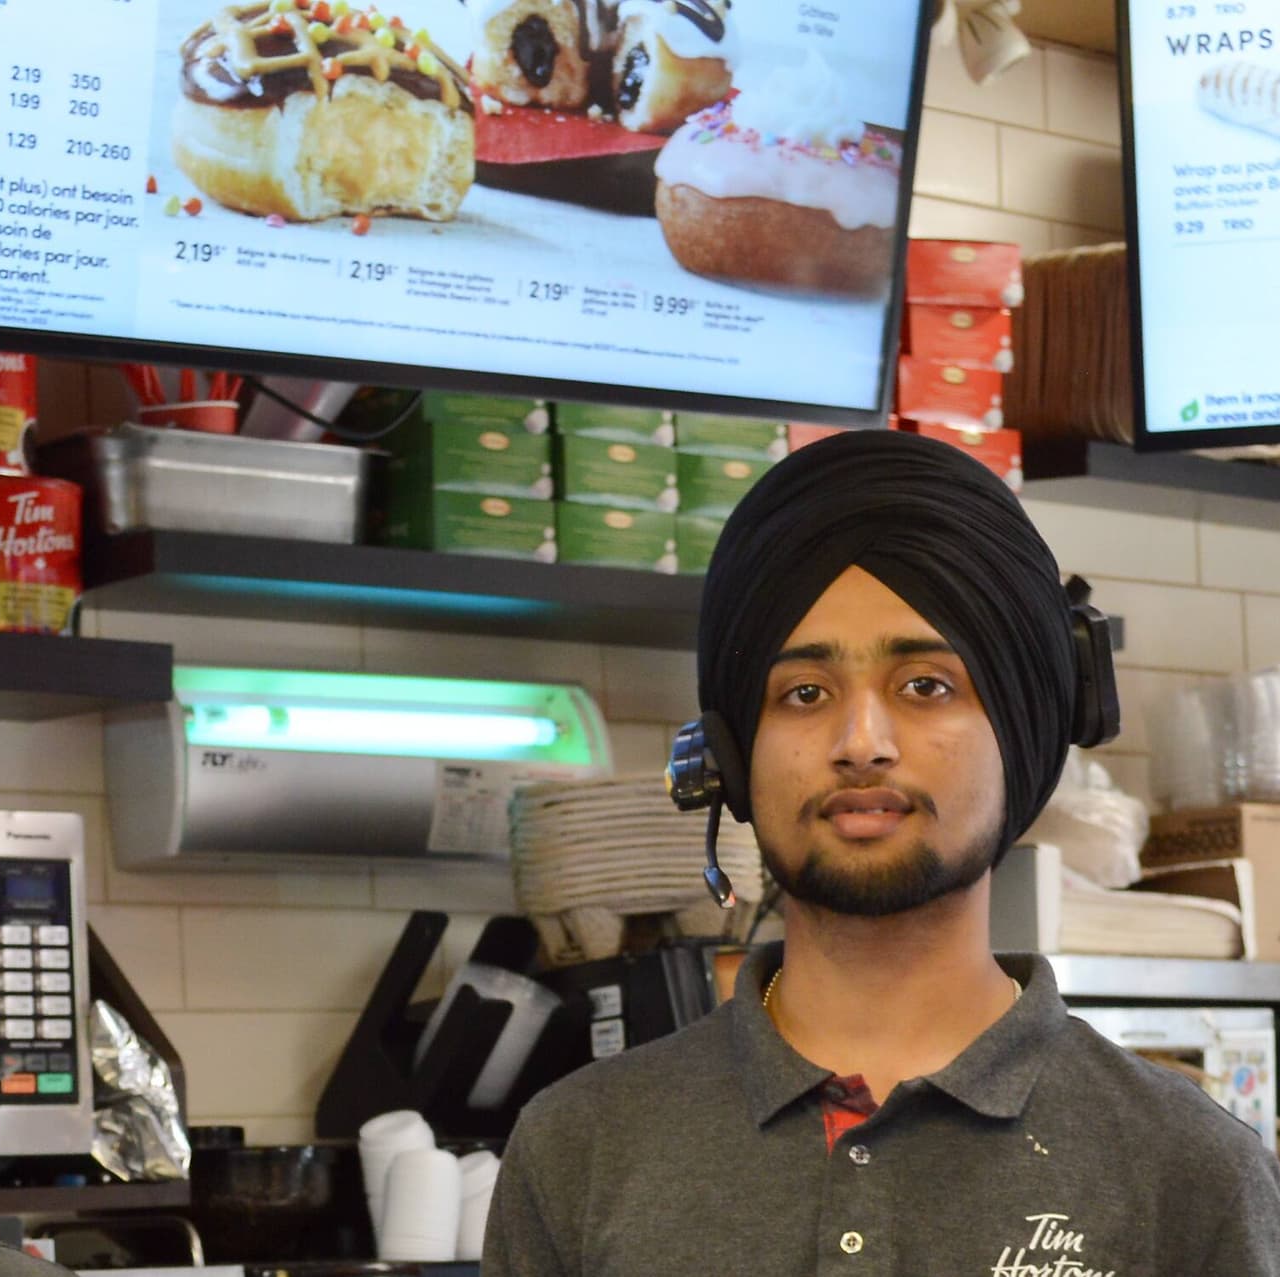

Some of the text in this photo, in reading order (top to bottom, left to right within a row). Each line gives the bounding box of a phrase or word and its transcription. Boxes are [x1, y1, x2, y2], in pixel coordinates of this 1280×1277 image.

[1166, 29, 1273, 56] WRAPS
[70, 73, 101, 92] 350
[68, 98, 100, 118] 260
[65, 139, 132, 162] 210-260
[8, 177, 49, 200] plus)
[51, 184, 78, 199] ont
[81, 184, 133, 205] besoin
[8, 200, 71, 221] calories
[75, 210, 102, 226] par
[103, 208, 140, 230] jour.
[7, 491, 55, 525] Tim
[1025, 1213, 1084, 1252] Tim
